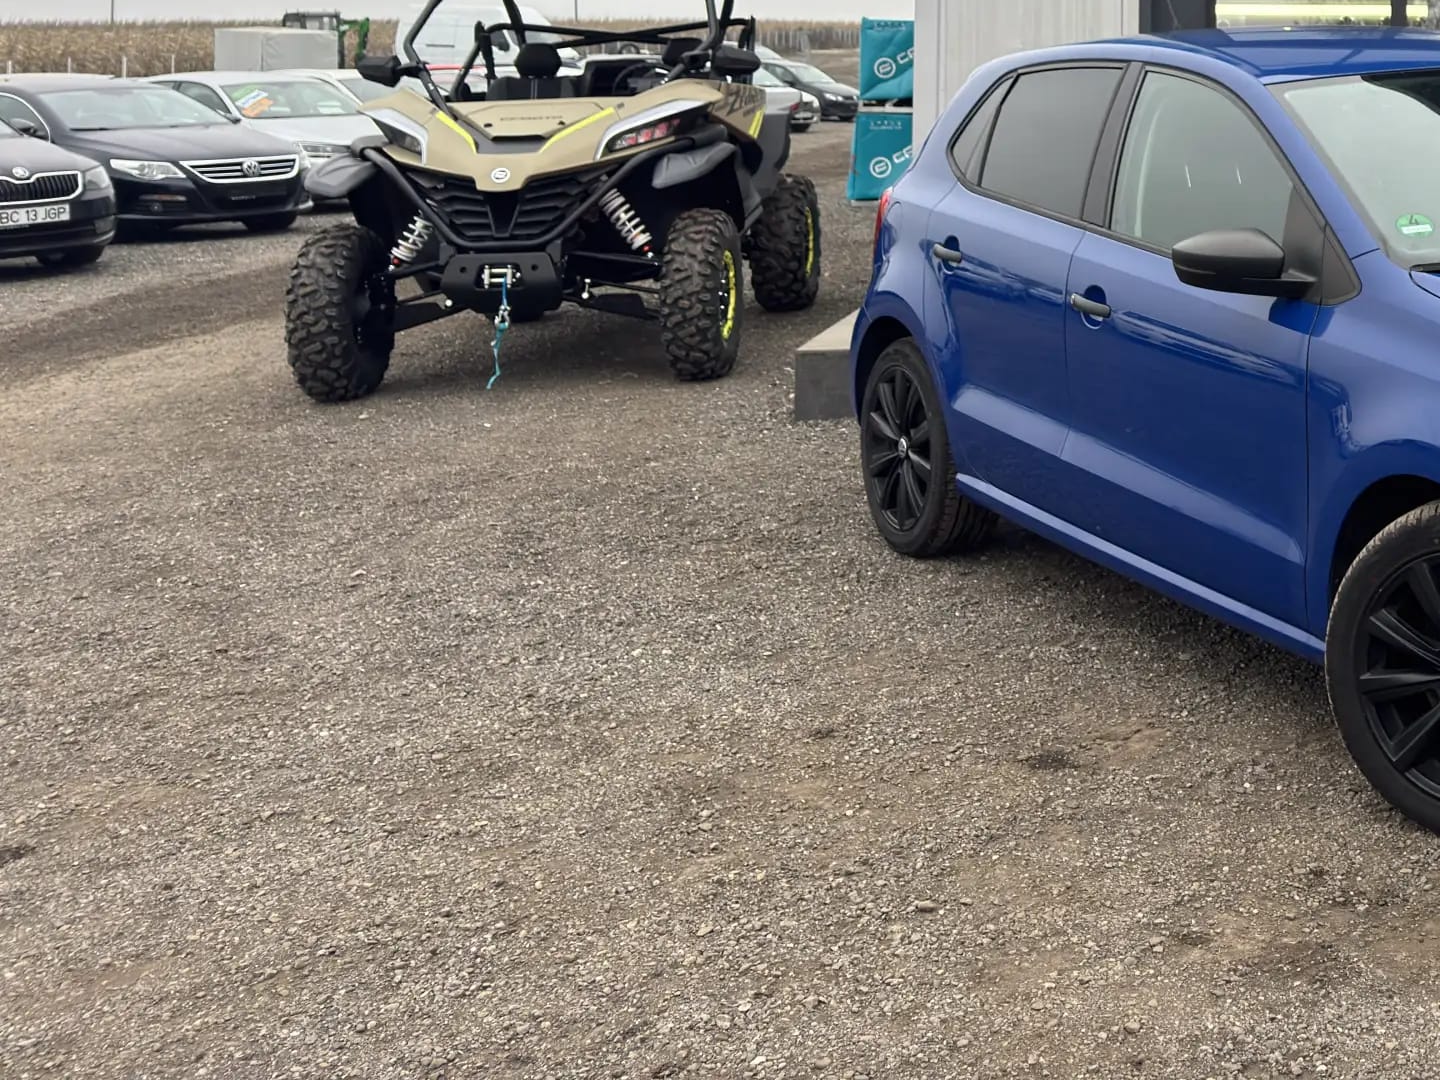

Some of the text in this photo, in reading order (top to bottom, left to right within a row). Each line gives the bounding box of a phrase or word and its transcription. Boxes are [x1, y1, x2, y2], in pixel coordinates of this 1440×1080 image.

[0, 207, 66, 224] BC 13 JGP
